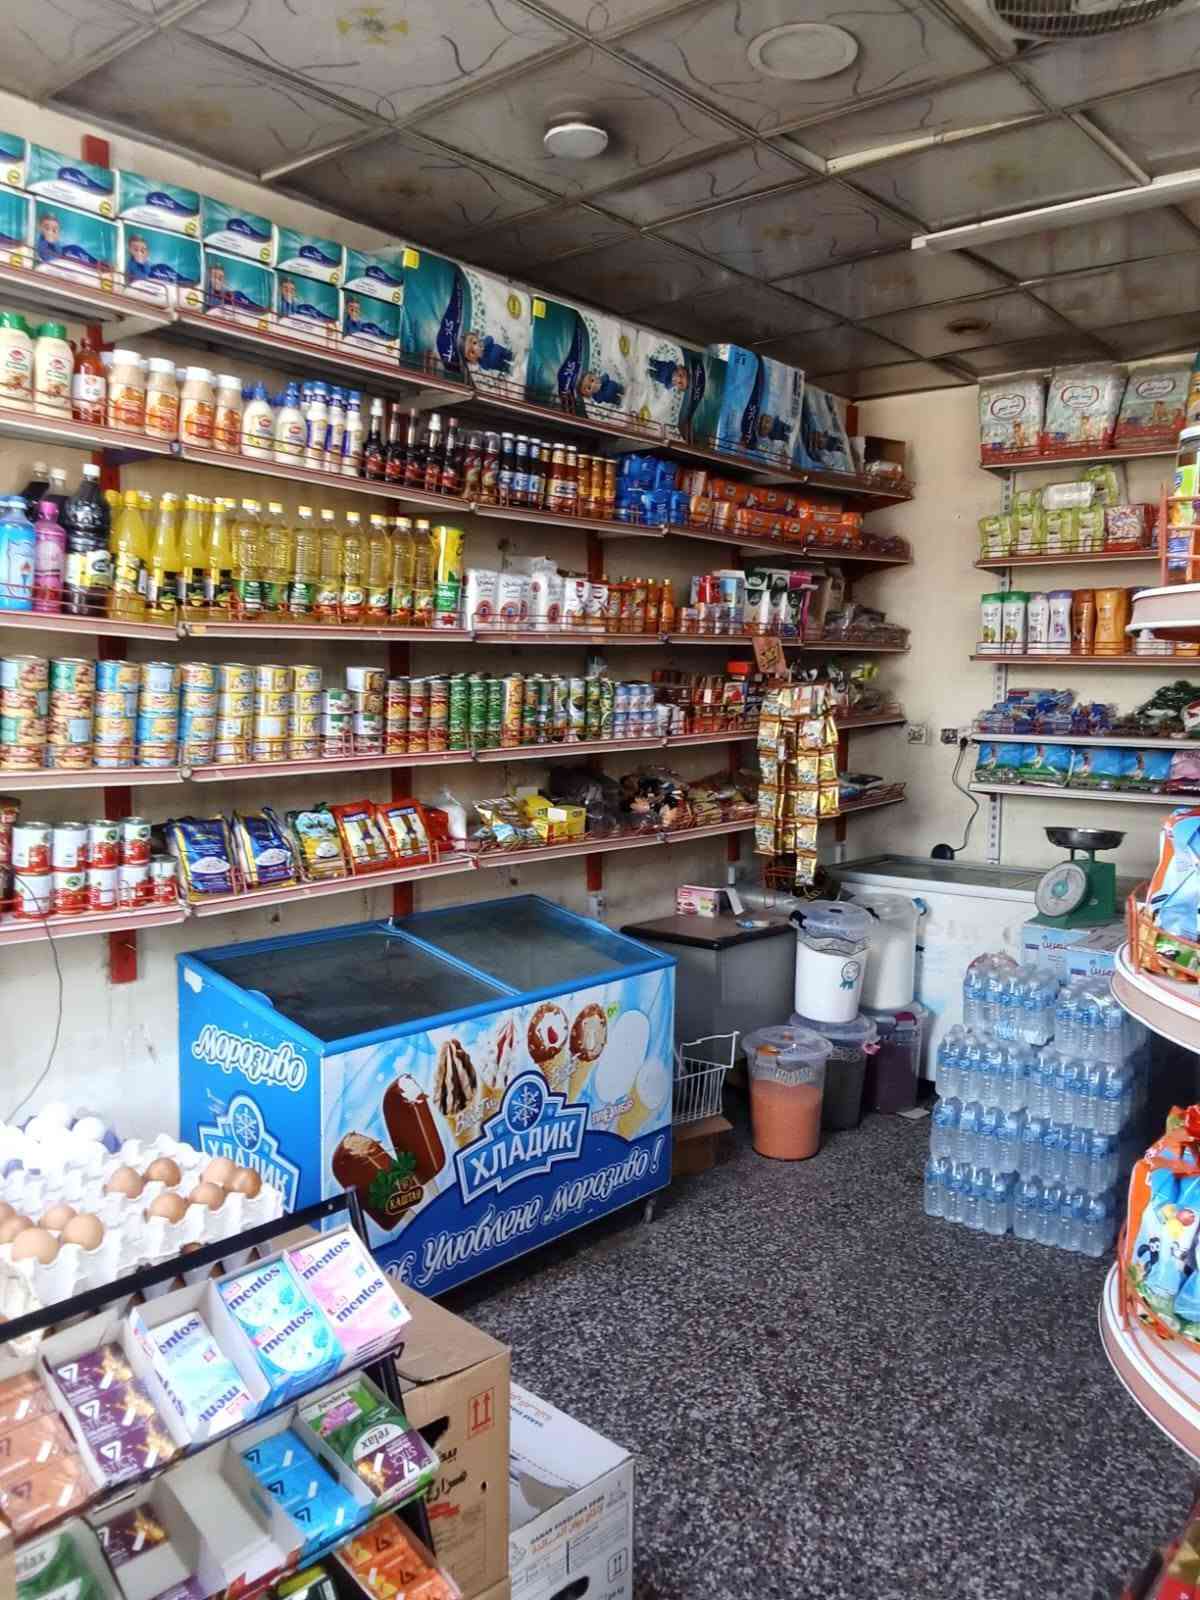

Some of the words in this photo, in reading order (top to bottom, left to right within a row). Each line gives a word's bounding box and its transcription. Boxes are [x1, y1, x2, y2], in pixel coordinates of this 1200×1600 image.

[470, 1119, 576, 1185] ХЛАДИК
[301, 1237, 351, 1281] mentos
[416, 1195, 541, 1288] Улюблене
[228, 1264, 282, 1311] mentos
[335, 1277, 385, 1323] mentos
[158, 1317, 201, 1355] entos
[261, 1307, 314, 1355] mentos
[360, 1427, 391, 1450] relax
